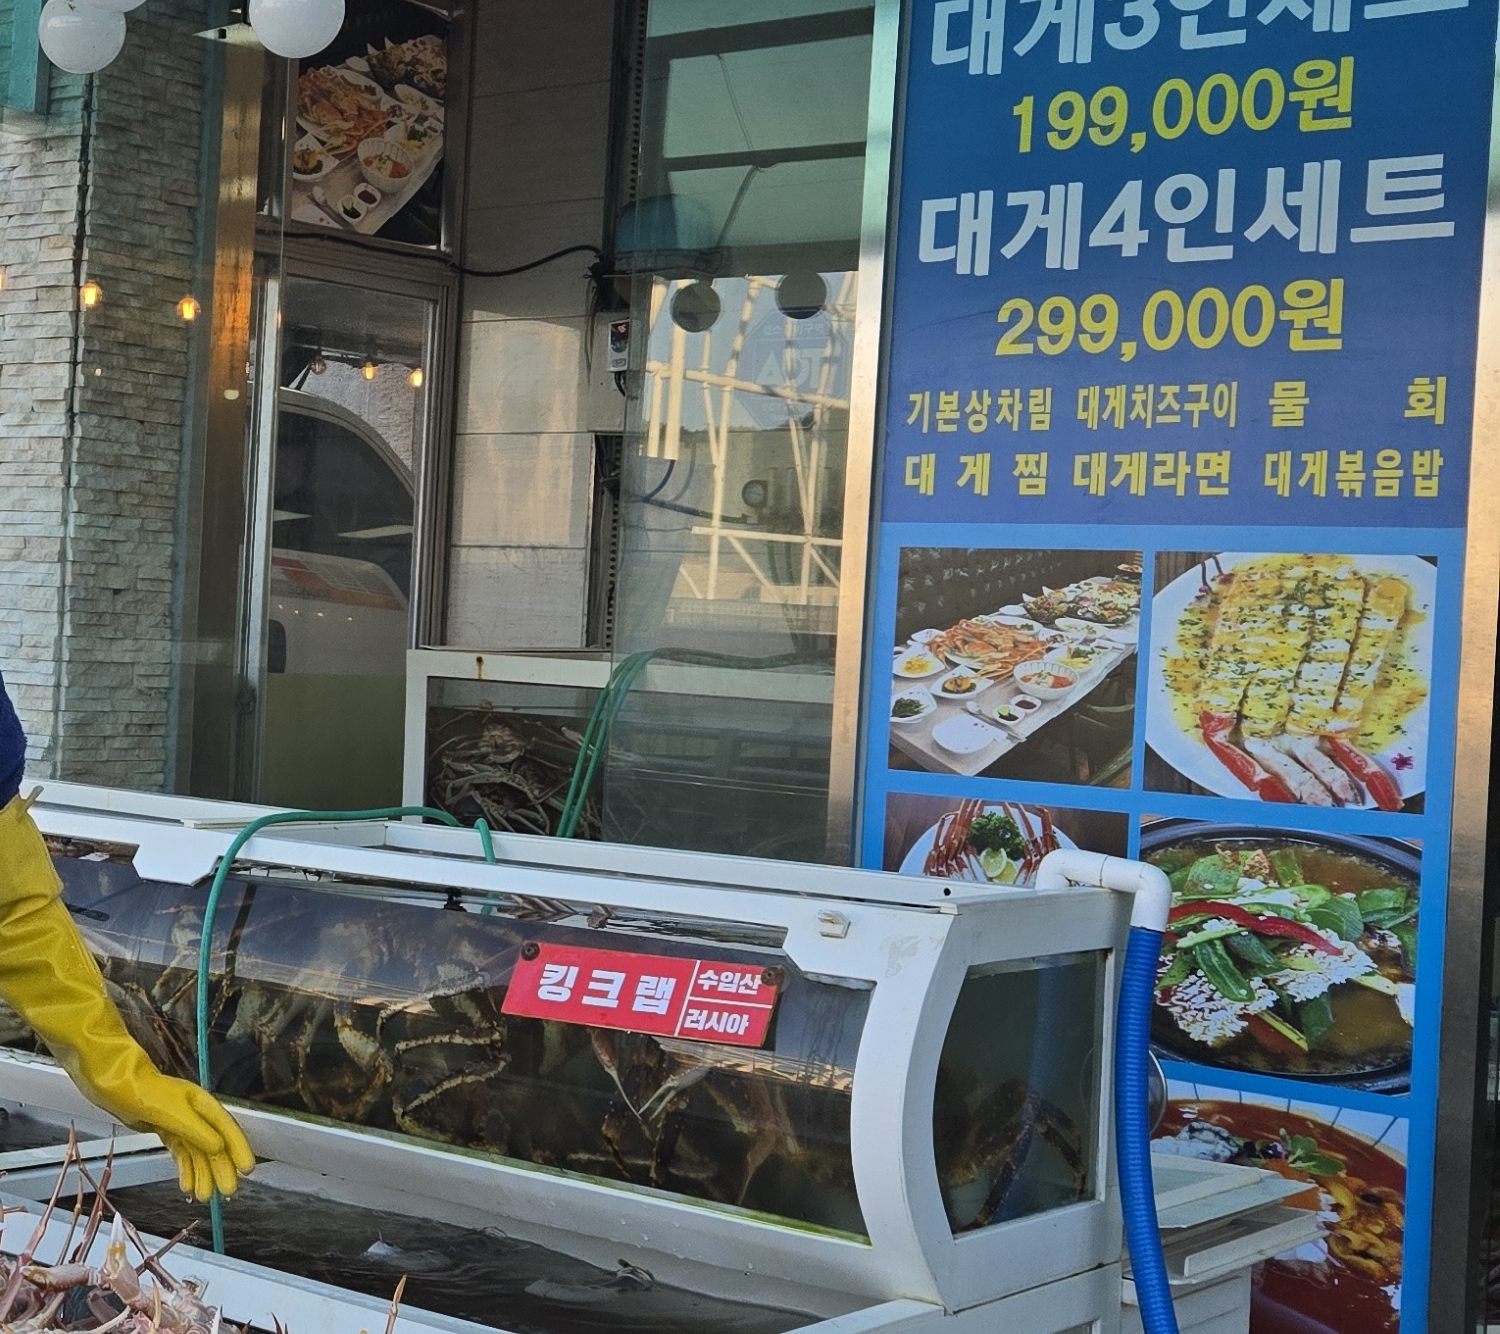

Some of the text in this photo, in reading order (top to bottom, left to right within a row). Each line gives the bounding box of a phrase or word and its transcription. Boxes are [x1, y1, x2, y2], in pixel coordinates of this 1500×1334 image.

[1013, 56, 1354, 153] 199,000원
[918, 153, 1455, 276] 대게4인세트
[995, 278, 1345, 362] 299,000원
[906, 386, 1053, 434] 기본상차림
[1077, 381, 1238, 430] 대게치즈구이
[1073, 450, 1231, 497] 대게라면
[1263, 448, 1444, 498] 대게볶음밥
[537, 964, 676, 1015] 킹크랩
[697, 968, 762, 996] 수입산
[684, 1008, 750, 1036] 러시아
